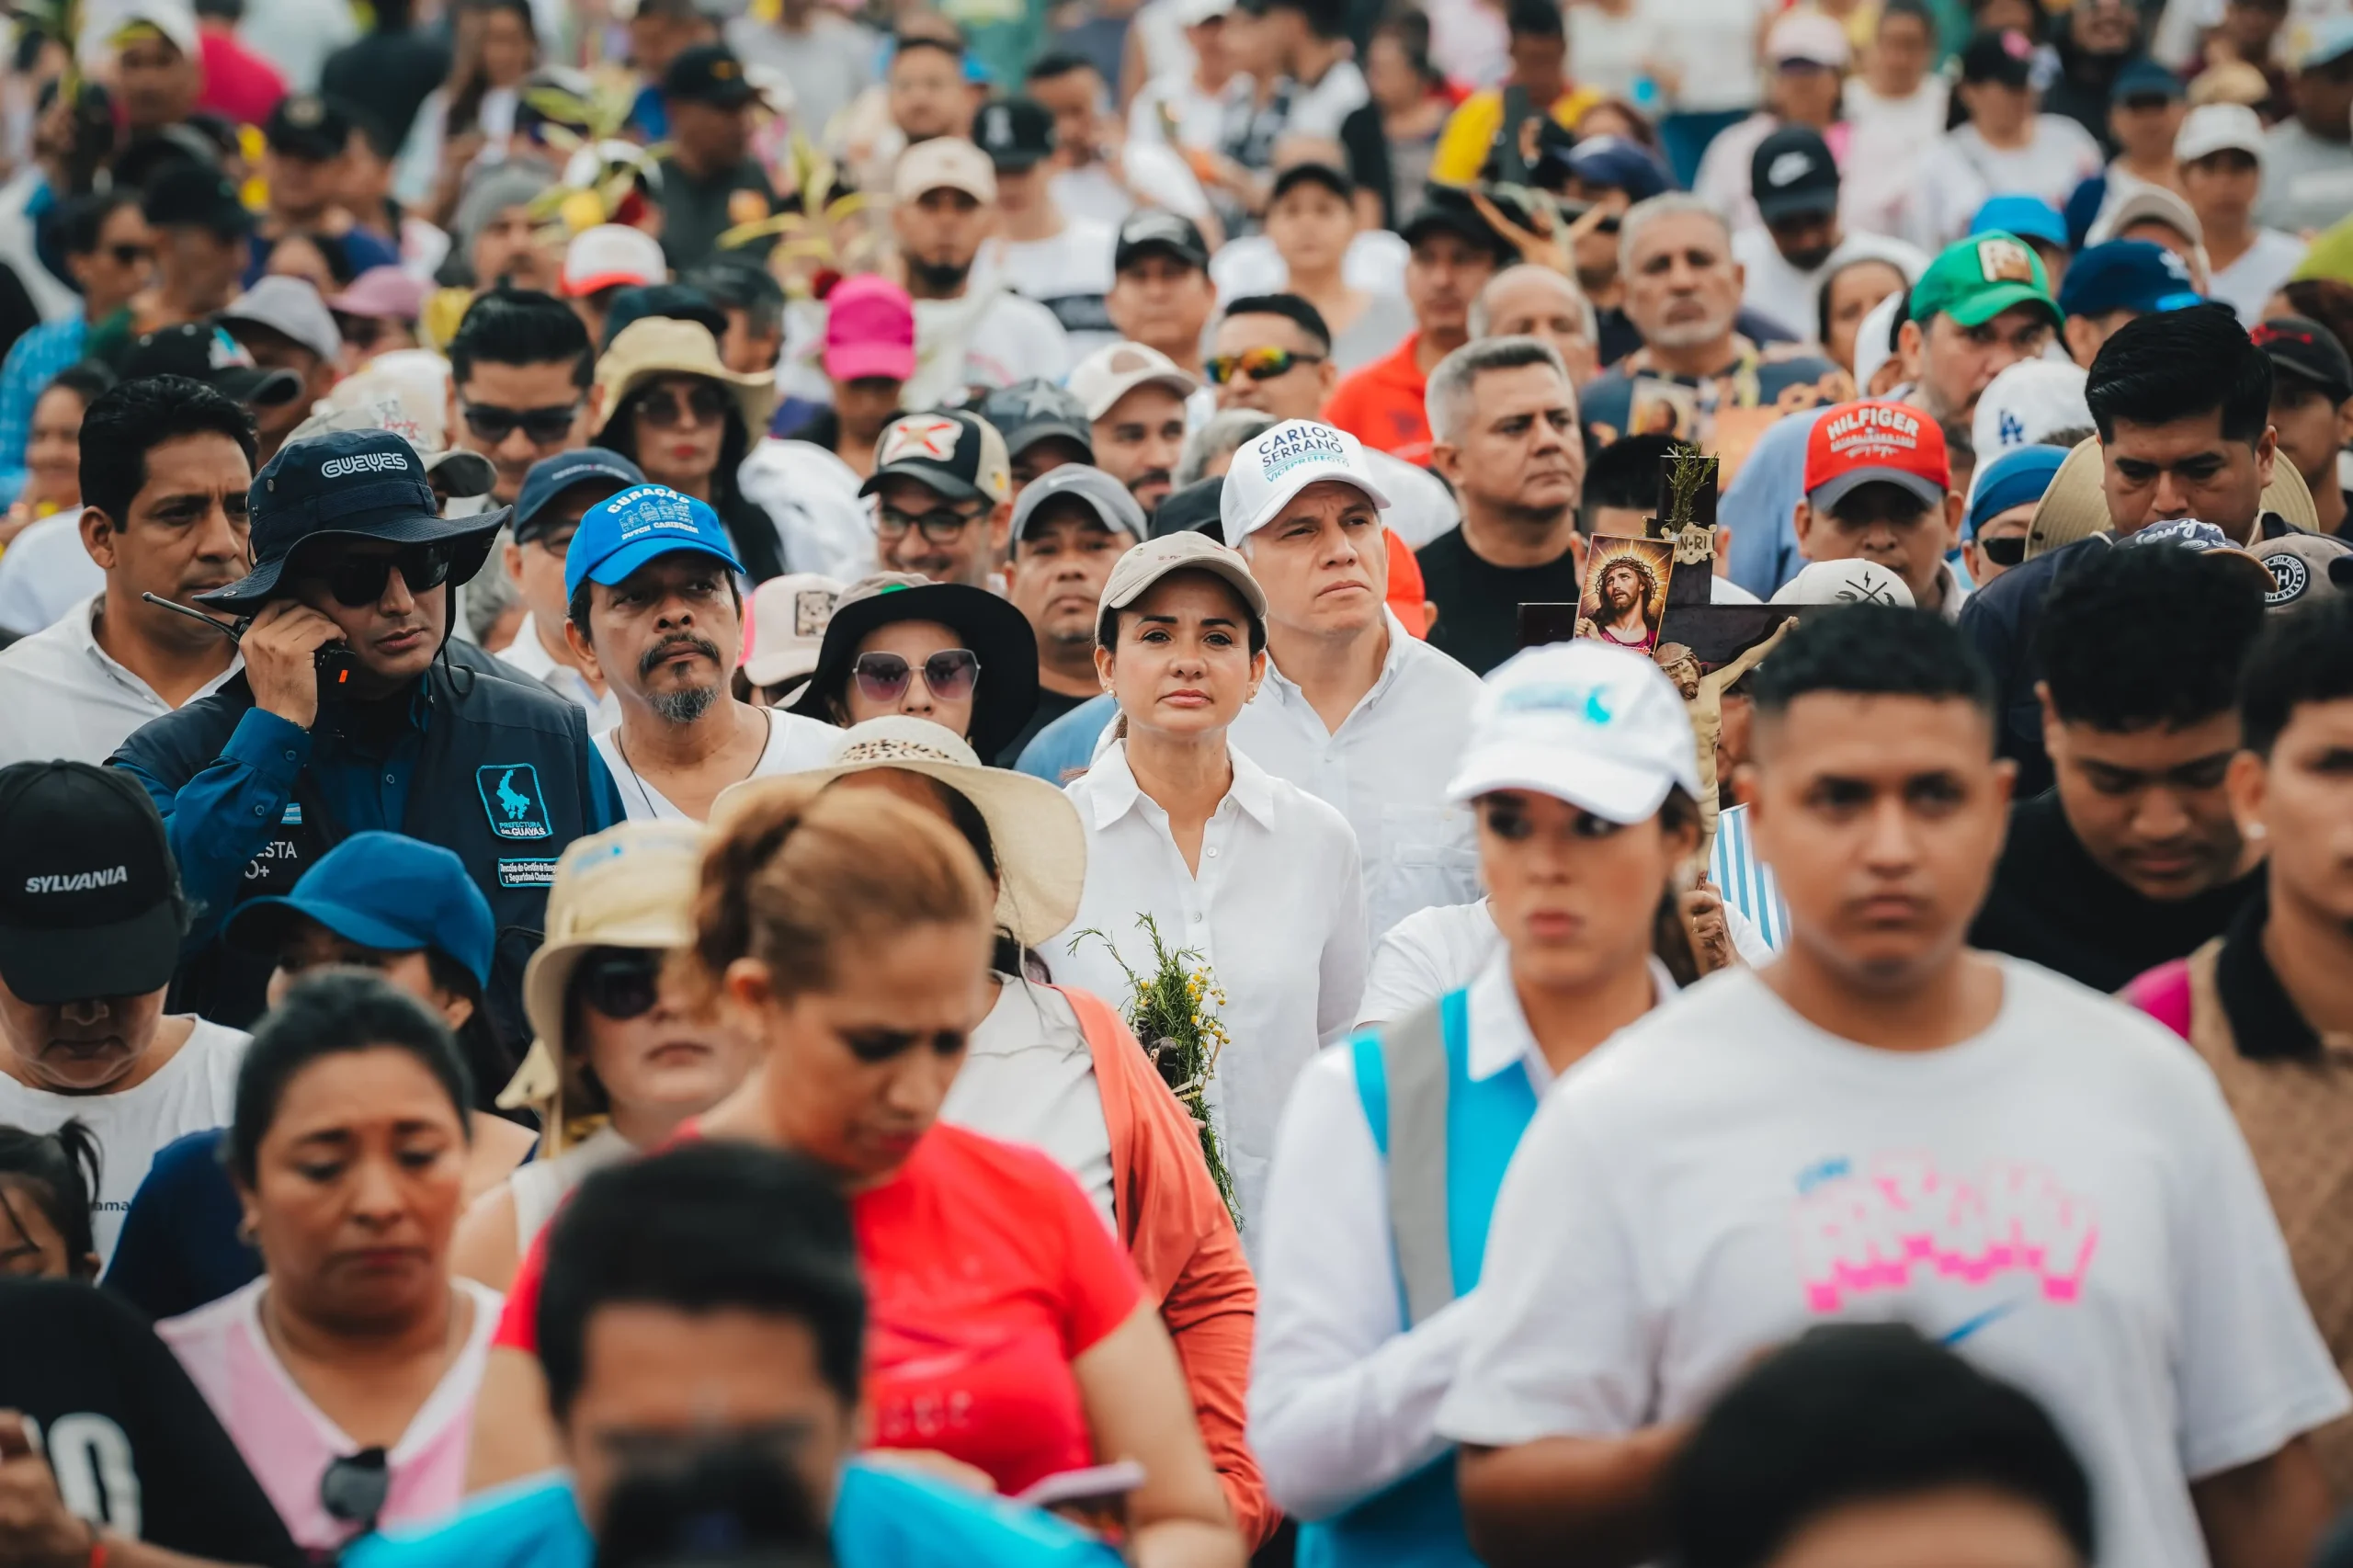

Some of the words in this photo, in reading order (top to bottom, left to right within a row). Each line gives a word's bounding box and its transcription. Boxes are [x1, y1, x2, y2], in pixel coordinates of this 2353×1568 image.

[1826, 407, 1920, 441] HILFIGER
[1259, 426, 1339, 455] CARLOS
[1263, 439, 1344, 468] SERRANO
[1267, 456, 1349, 483] VICEPREFECTO
[621, 526, 651, 540] DUTCH
[653, 521, 699, 535] CARIBBEAN
[511, 827, 546, 836] GUAYAS
[25, 866, 128, 893] SYLVANIA
